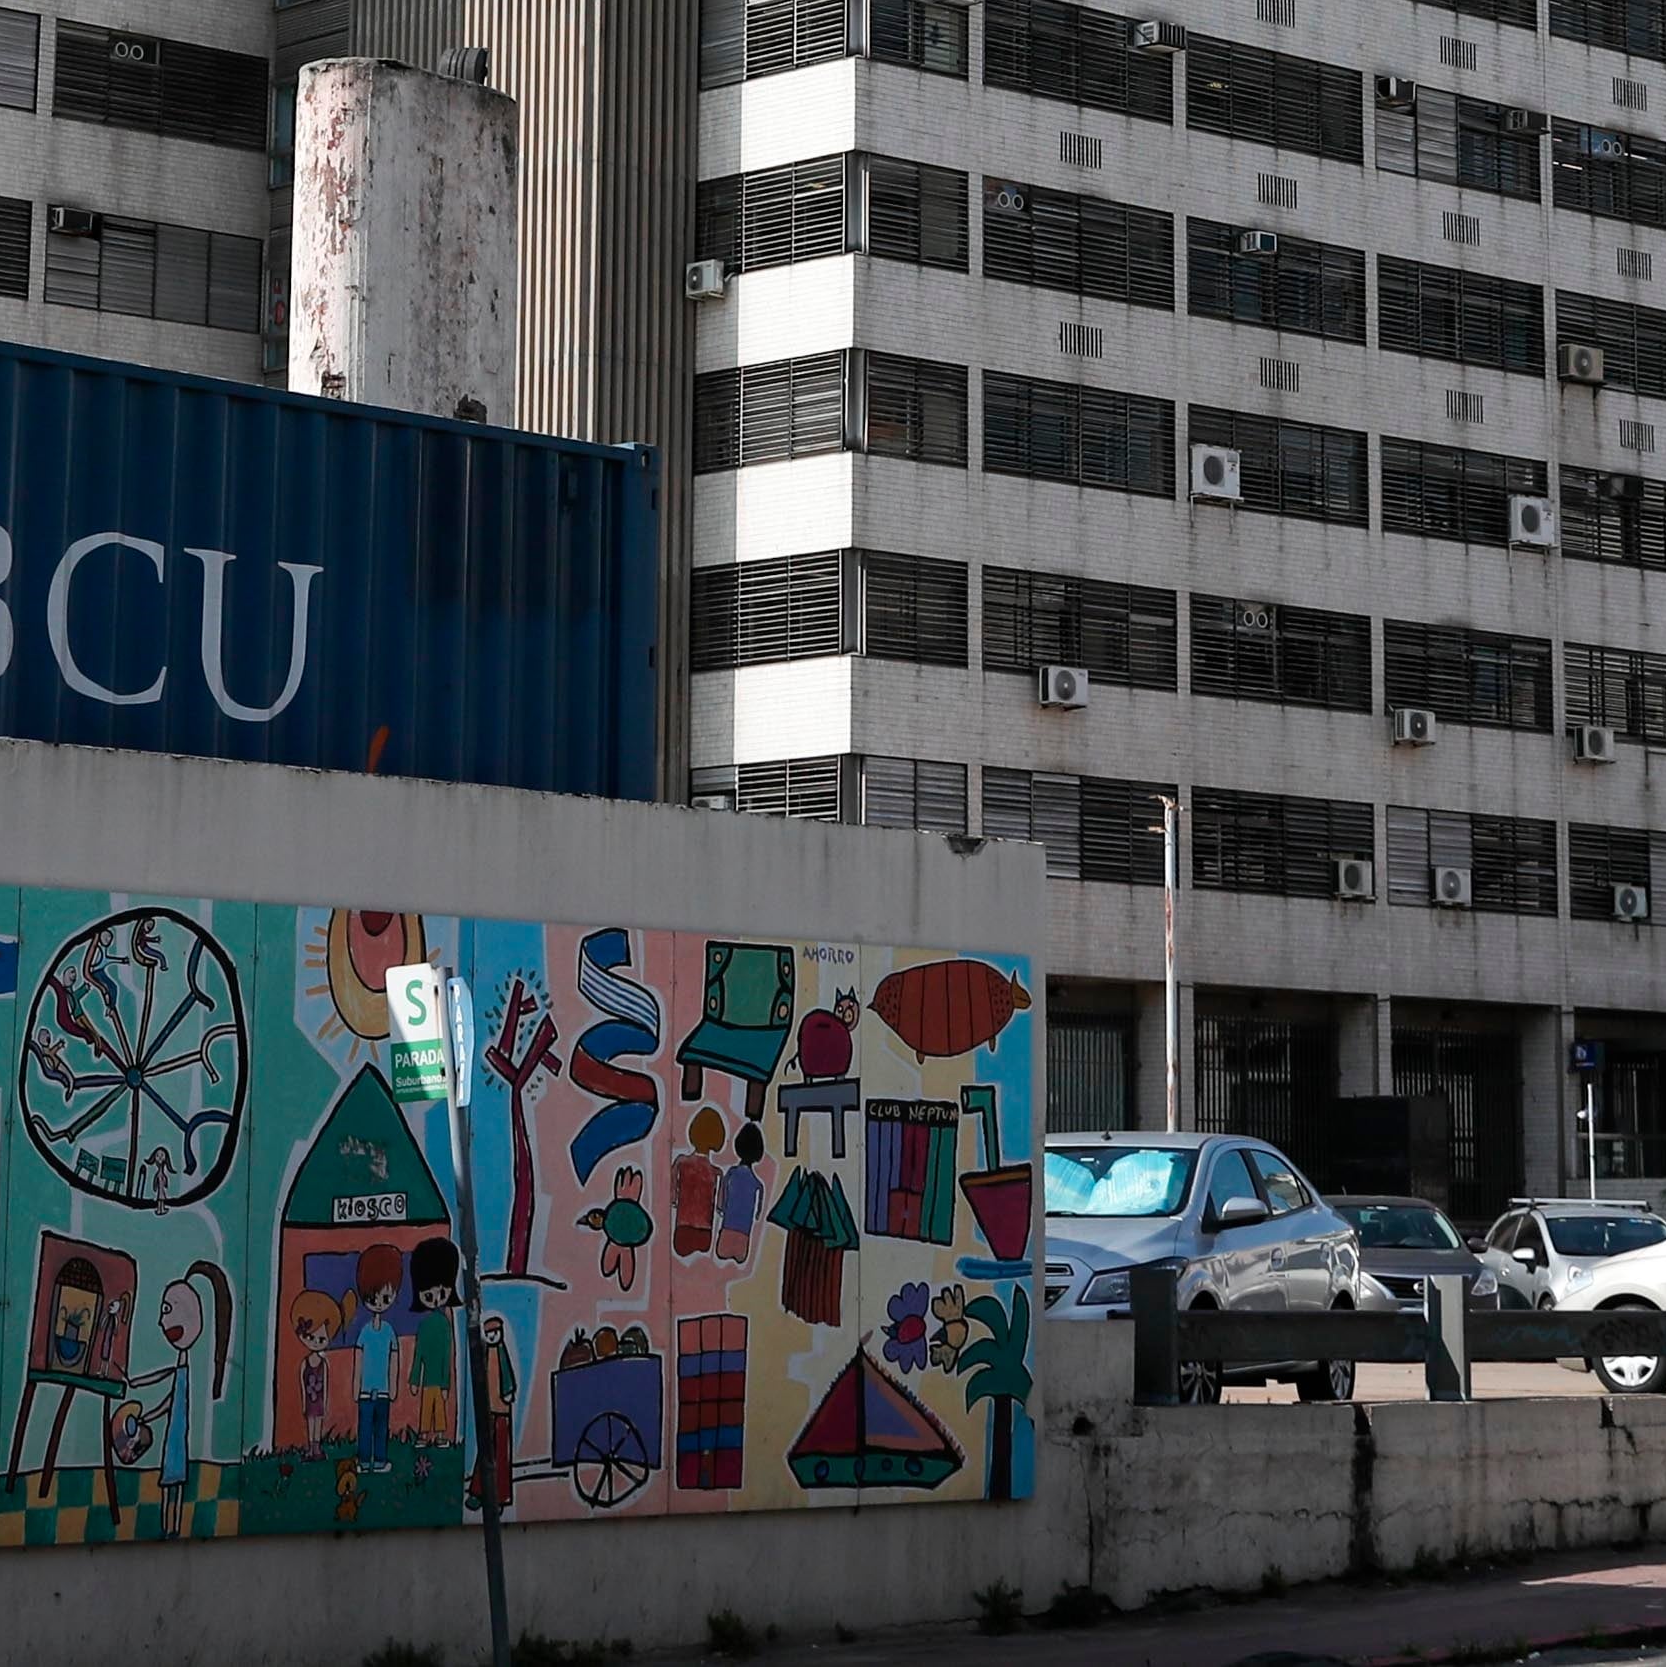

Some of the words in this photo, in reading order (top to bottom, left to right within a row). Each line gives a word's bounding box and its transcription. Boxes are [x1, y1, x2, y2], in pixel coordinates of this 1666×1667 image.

[802, 945, 855, 965] AHORRO
[405, 979, 428, 1026] S
[394, 1047, 446, 1070] PARADA
[868, 1102, 902, 1118] CLUB
